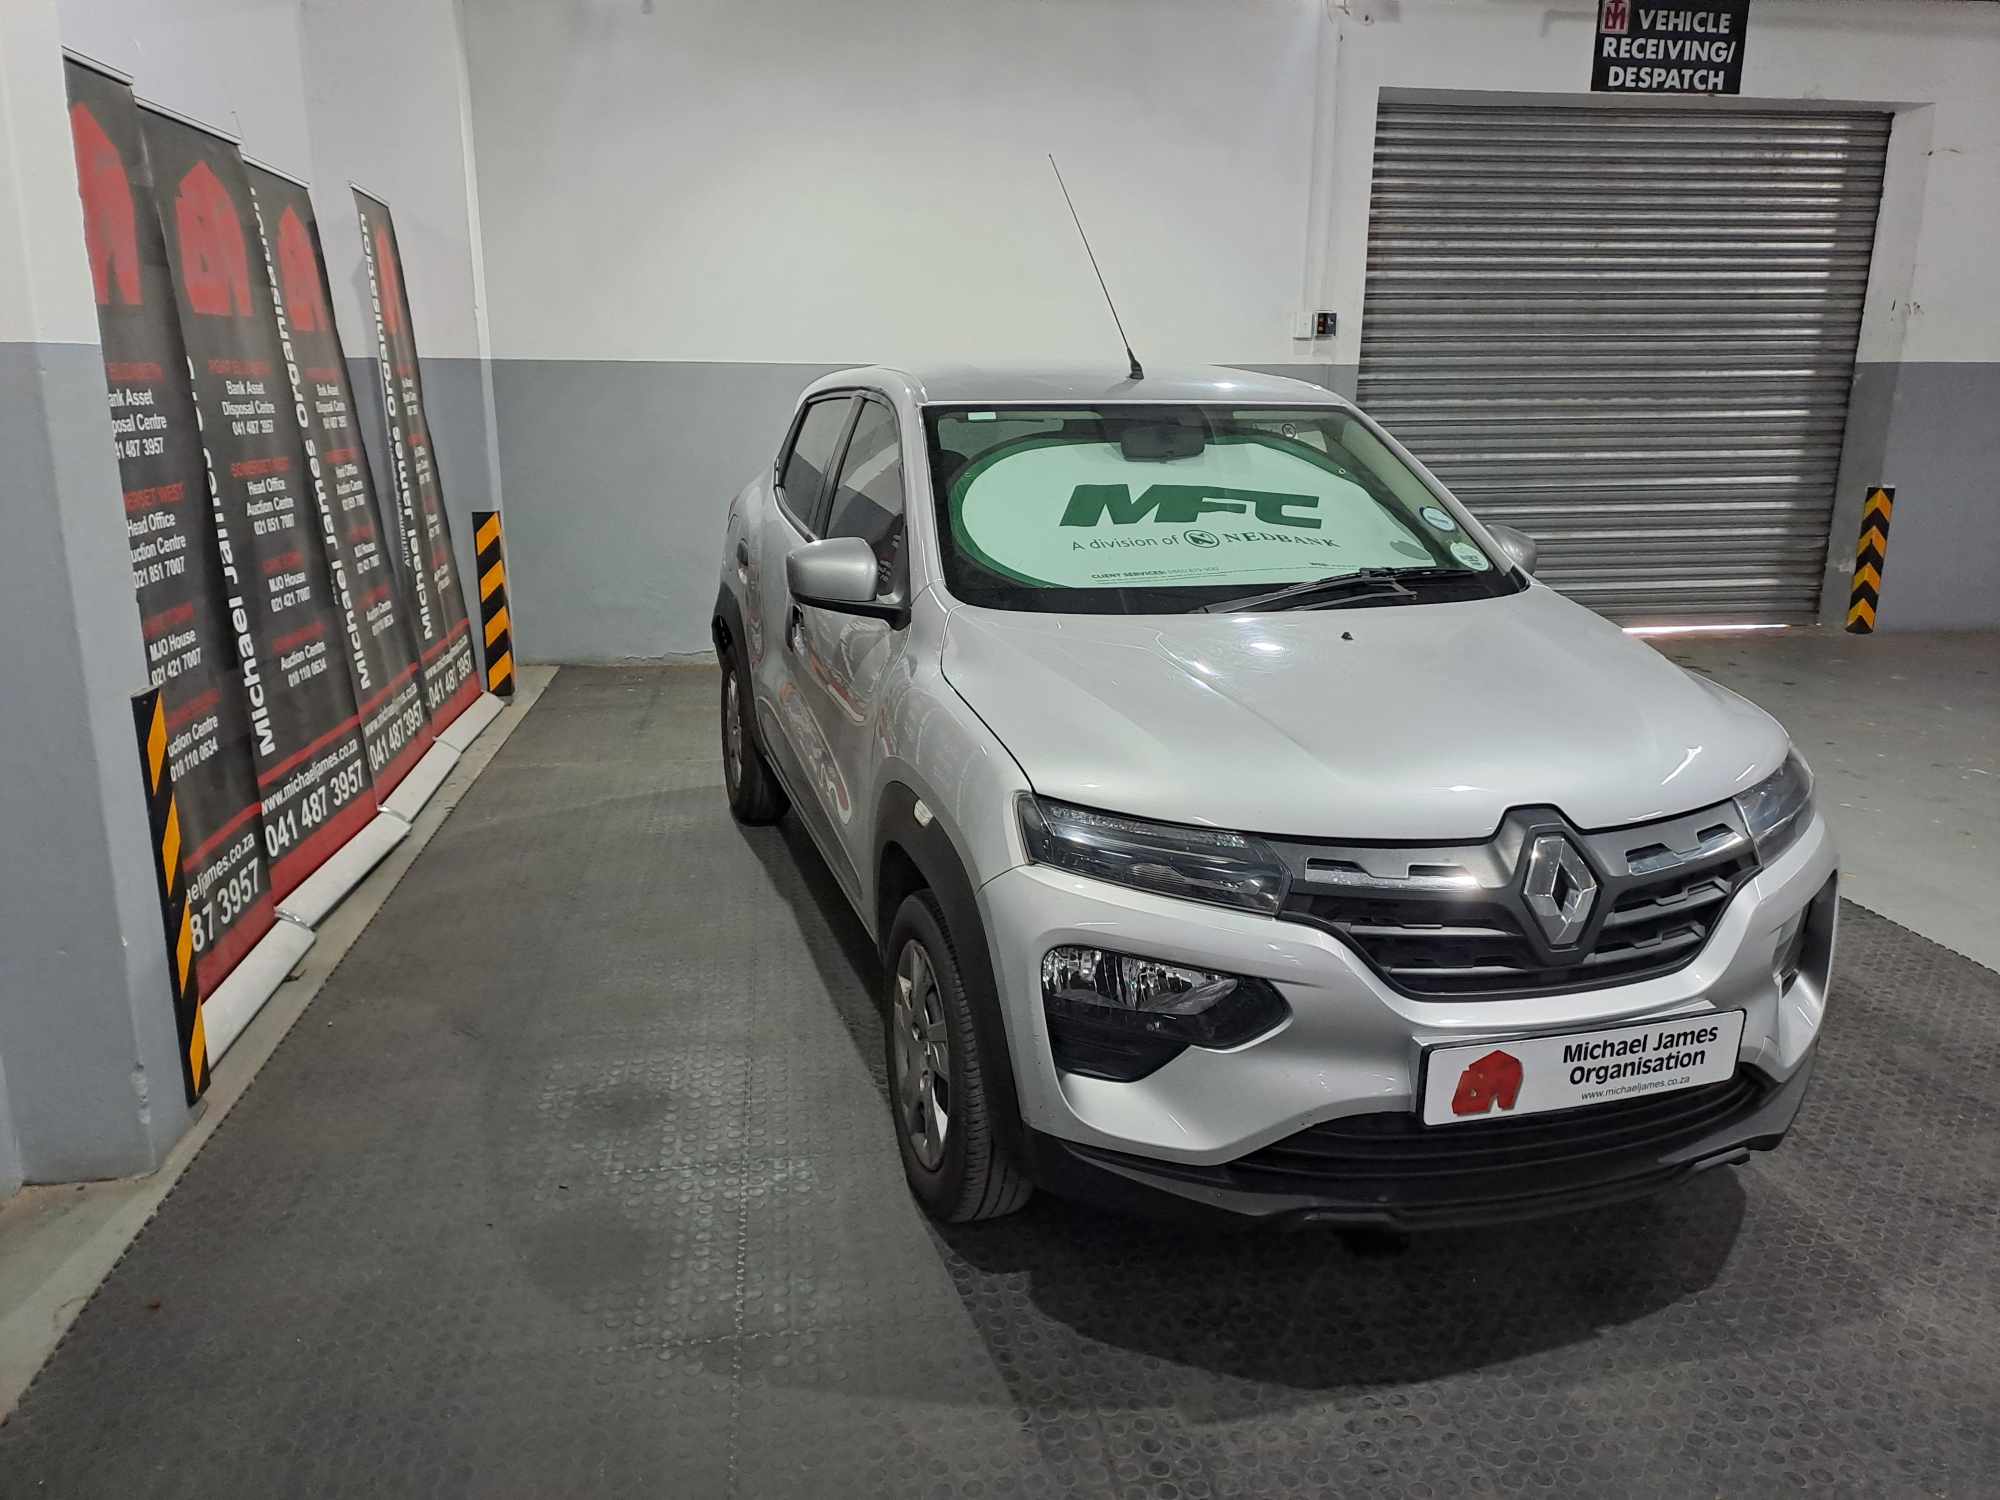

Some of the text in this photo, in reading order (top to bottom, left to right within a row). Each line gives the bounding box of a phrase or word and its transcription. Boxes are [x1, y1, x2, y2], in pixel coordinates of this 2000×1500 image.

[1639, 9, 1732, 33] VEHICLE
[1602, 37, 1736, 63] RECEIVING/
[1608, 66, 1725, 90] DESPATCH
[107, 387, 154, 407] ank Asset
[111, 413, 167, 438] posal Centre
[125, 439, 140, 457] 487
[142, 437, 164, 455] 3957
[392, 426, 414, 521] James
[305, 439, 338, 551] James
[1060, 484, 1322, 529] MFC
[127, 511, 176, 537] Head Office
[130, 534, 187, 563] uction Centre
[1071, 531, 1342, 551] A division of NEDBANK
[149, 562, 165, 582] 851
[164, 555, 185, 577] 7007
[407, 529, 433, 640] Michael
[331, 560, 371, 690] Michael
[168, 630, 197, 652] House
[151, 665, 167, 686] 021
[167, 656, 182, 678] 421
[228, 596, 276, 757] Michael
[428, 679, 445, 709] 041
[167, 715, 219, 758] uction Centre
[369, 700, 424, 770] 041 487 3957
[184, 749, 200, 770] 110
[261, 739, 358, 816] www.michaeljames.co.za
[264, 758, 364, 857] 041 487 3957
[190, 857, 259, 952] 87 3957
[1563, 1025, 1718, 1064] Michael James
[1569, 1048, 1705, 1086] Organisation
[1580, 1075, 1691, 1101] www.michaeljames.co.za
